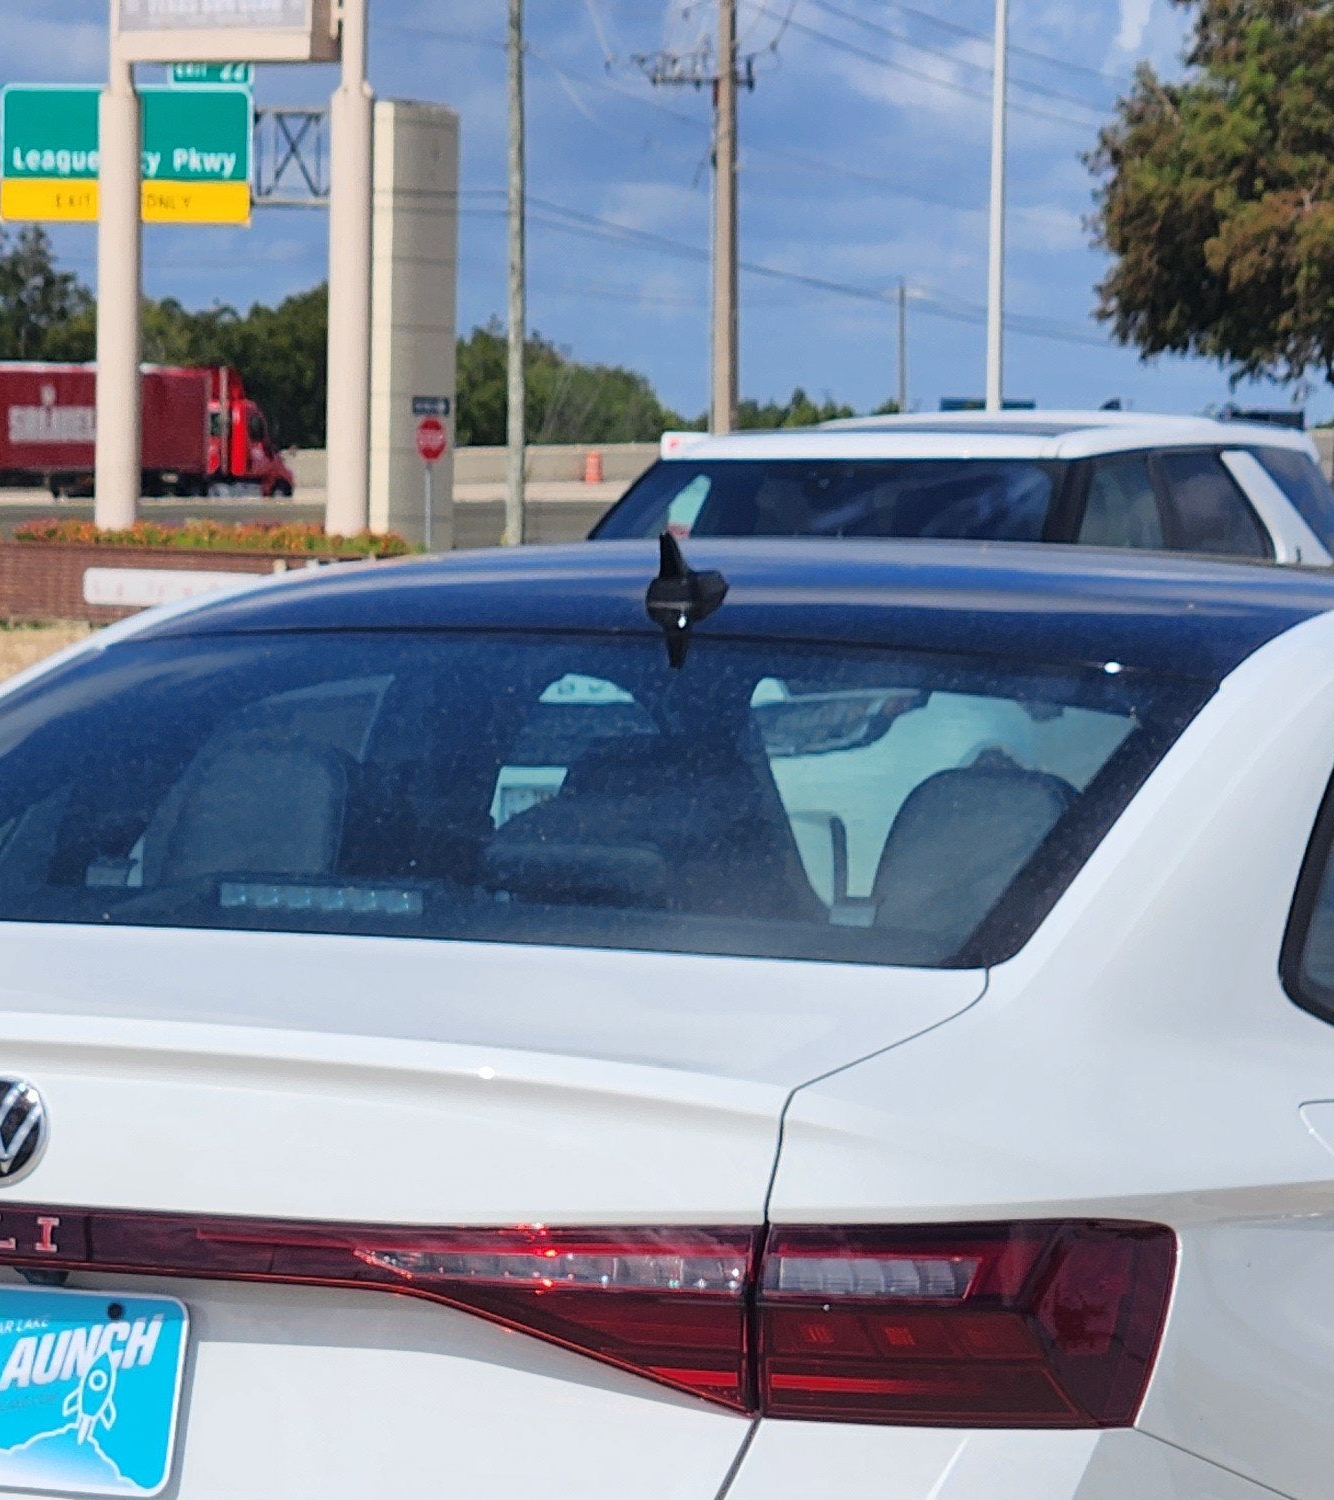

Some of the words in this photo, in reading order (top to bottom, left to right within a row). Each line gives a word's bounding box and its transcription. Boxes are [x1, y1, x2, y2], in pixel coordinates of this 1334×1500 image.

[12, 146, 99, 175] League
[172, 147, 236, 178] Pkwy
[146, 193, 192, 210] ONLY
[15, 1314, 51, 1333] LAKE
